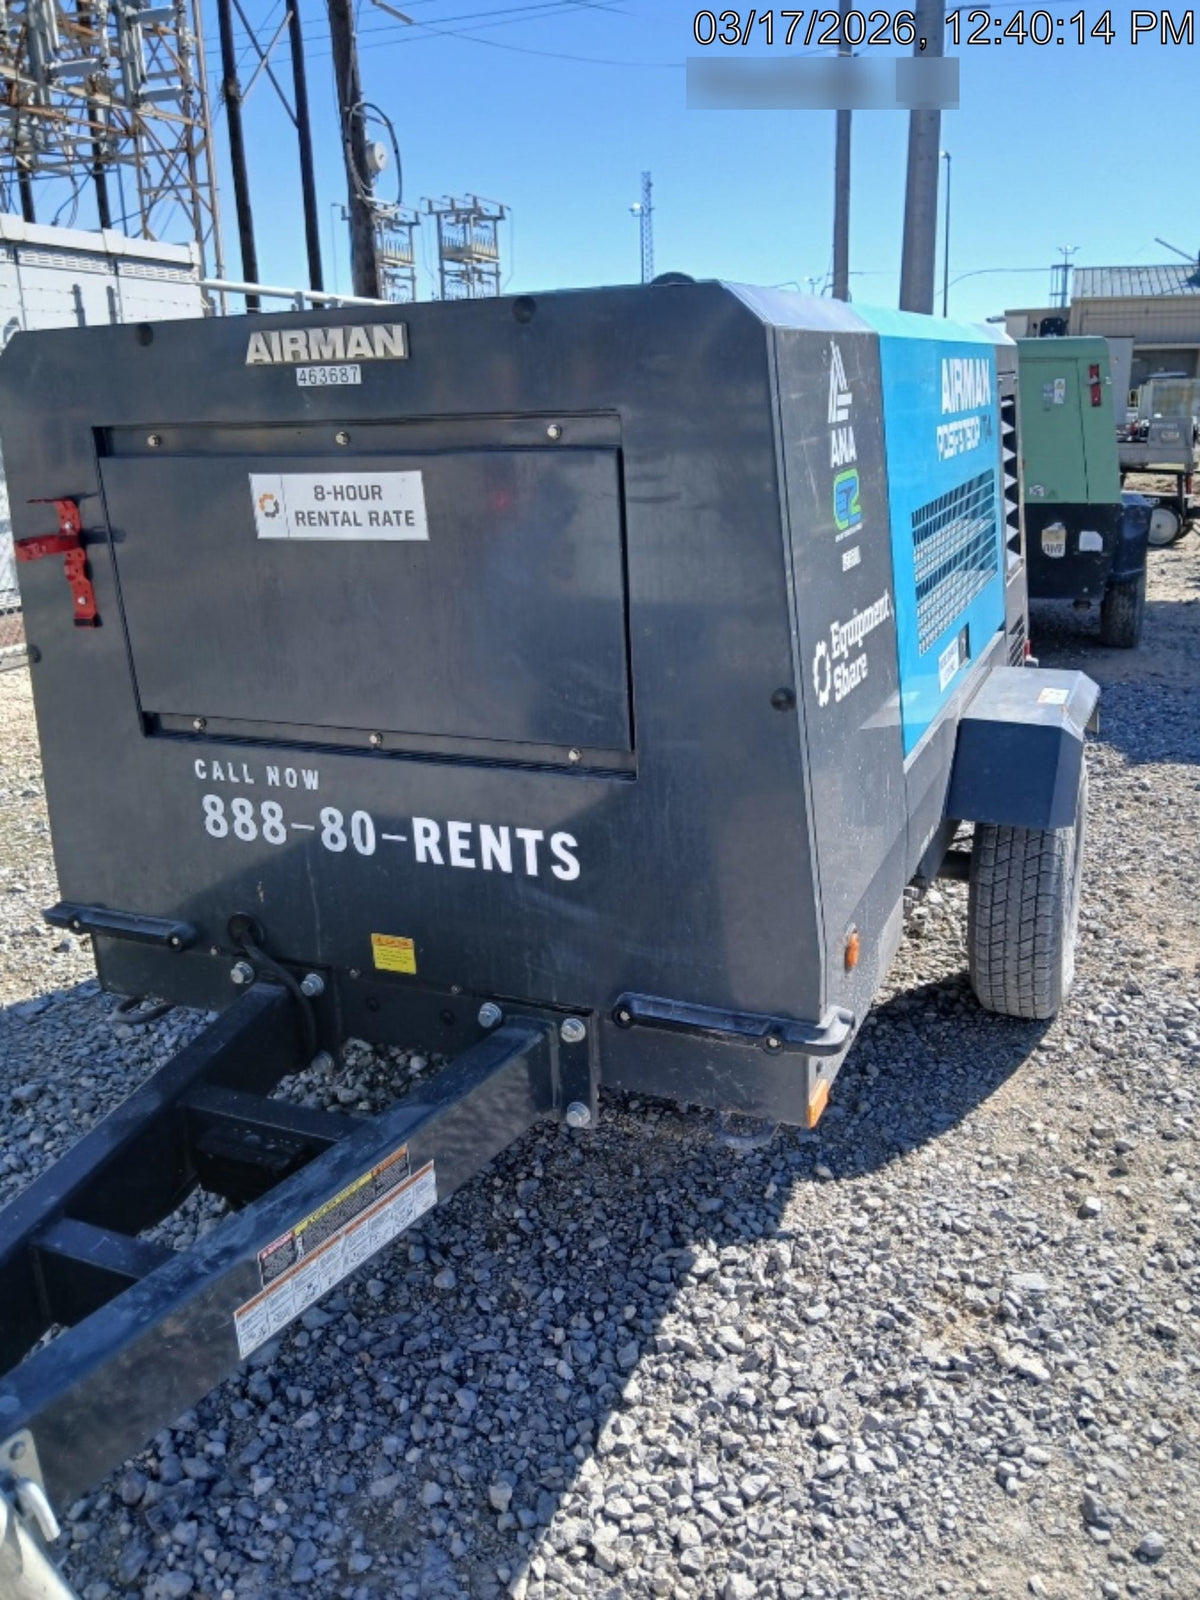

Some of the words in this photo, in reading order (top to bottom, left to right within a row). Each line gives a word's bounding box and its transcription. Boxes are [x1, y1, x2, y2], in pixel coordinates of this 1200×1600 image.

[246, 324, 405, 364] AIRMAN
[298, 366, 359, 385] 463687
[941, 358, 991, 415] AIRMAN
[830, 426, 858, 468] ANA
[313, 484, 383, 501] 8-HOUR
[294, 510, 363, 527] RENTAL
[368, 510, 415, 527] RATE
[829, 588, 891, 660] Equipment
[833, 652, 869, 703] Share
[194, 758, 255, 785] CALL
[265, 765, 320, 791] NOW
[201, 793, 581, 882] 888-80-RENTS
